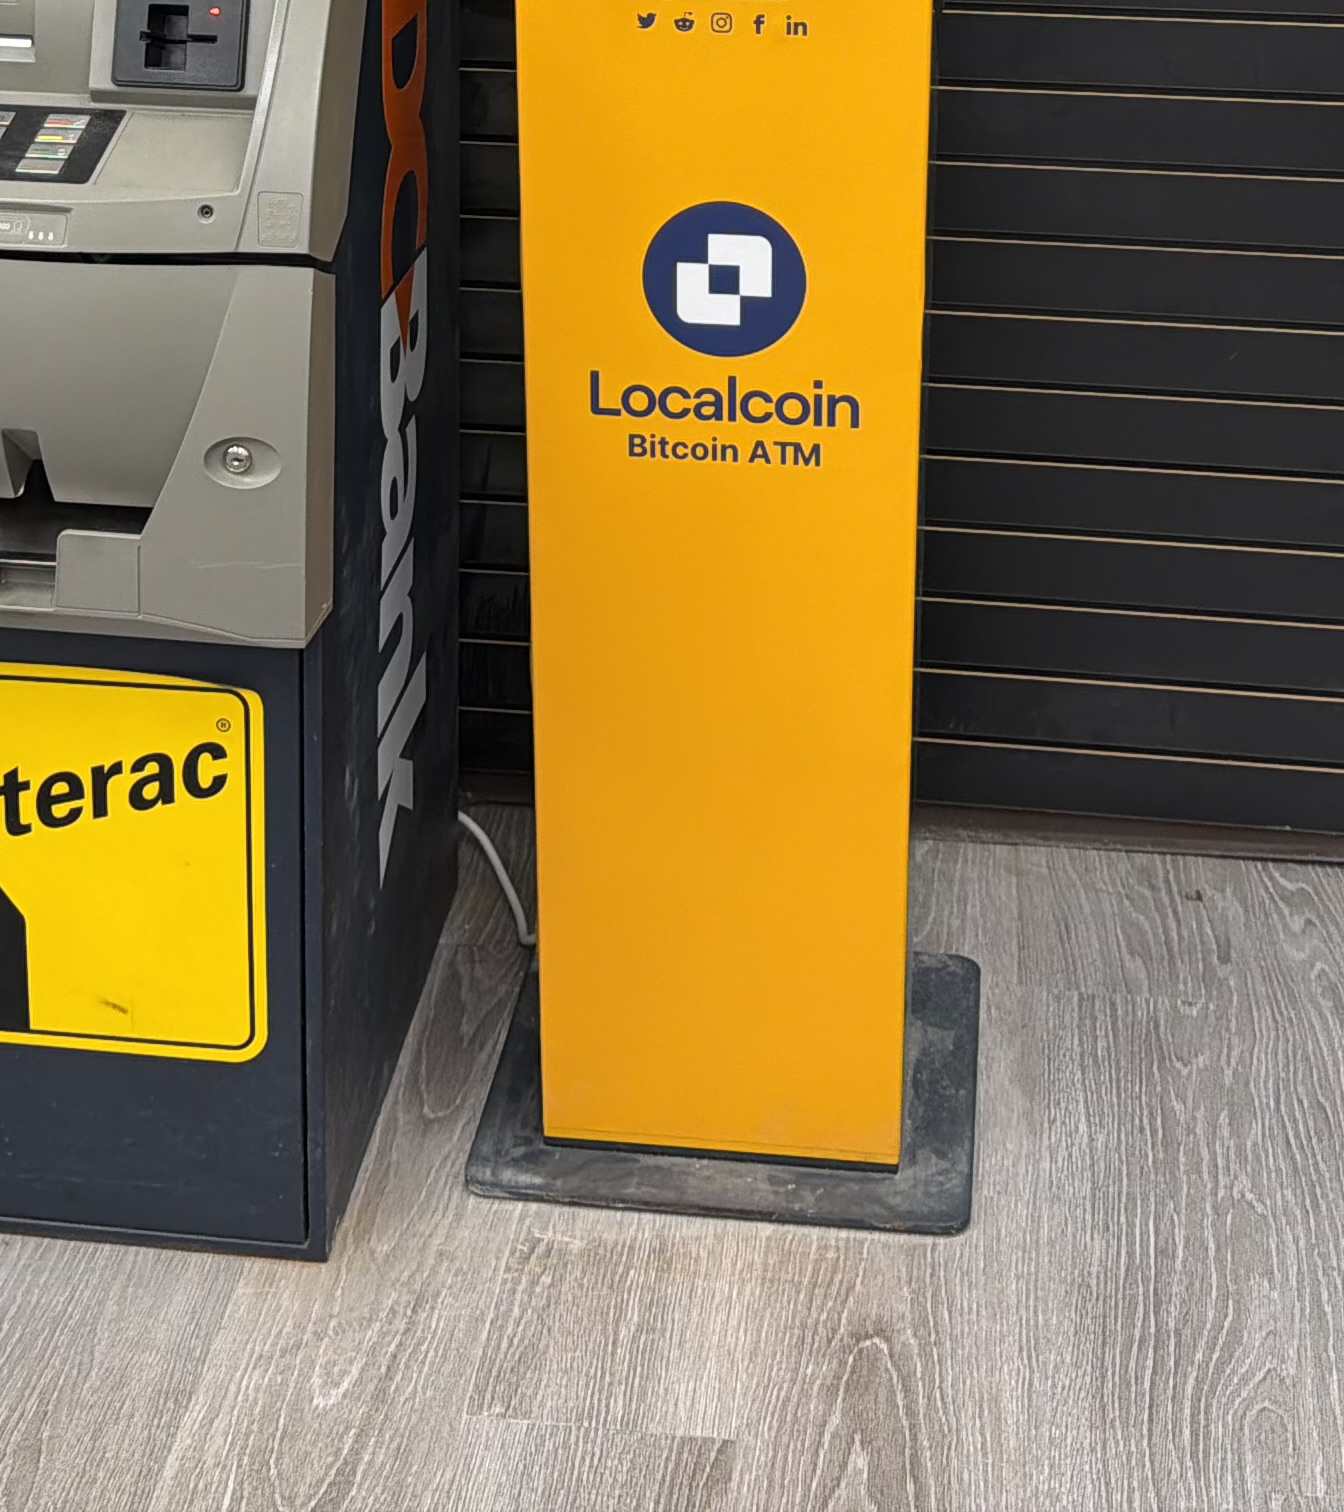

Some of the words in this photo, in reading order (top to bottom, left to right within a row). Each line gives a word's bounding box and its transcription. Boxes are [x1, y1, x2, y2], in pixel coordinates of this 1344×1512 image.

[589, 370, 861, 430] Localcoin
[627, 433, 739, 463] Bitcoin
[748, 439, 822, 468] ATM
